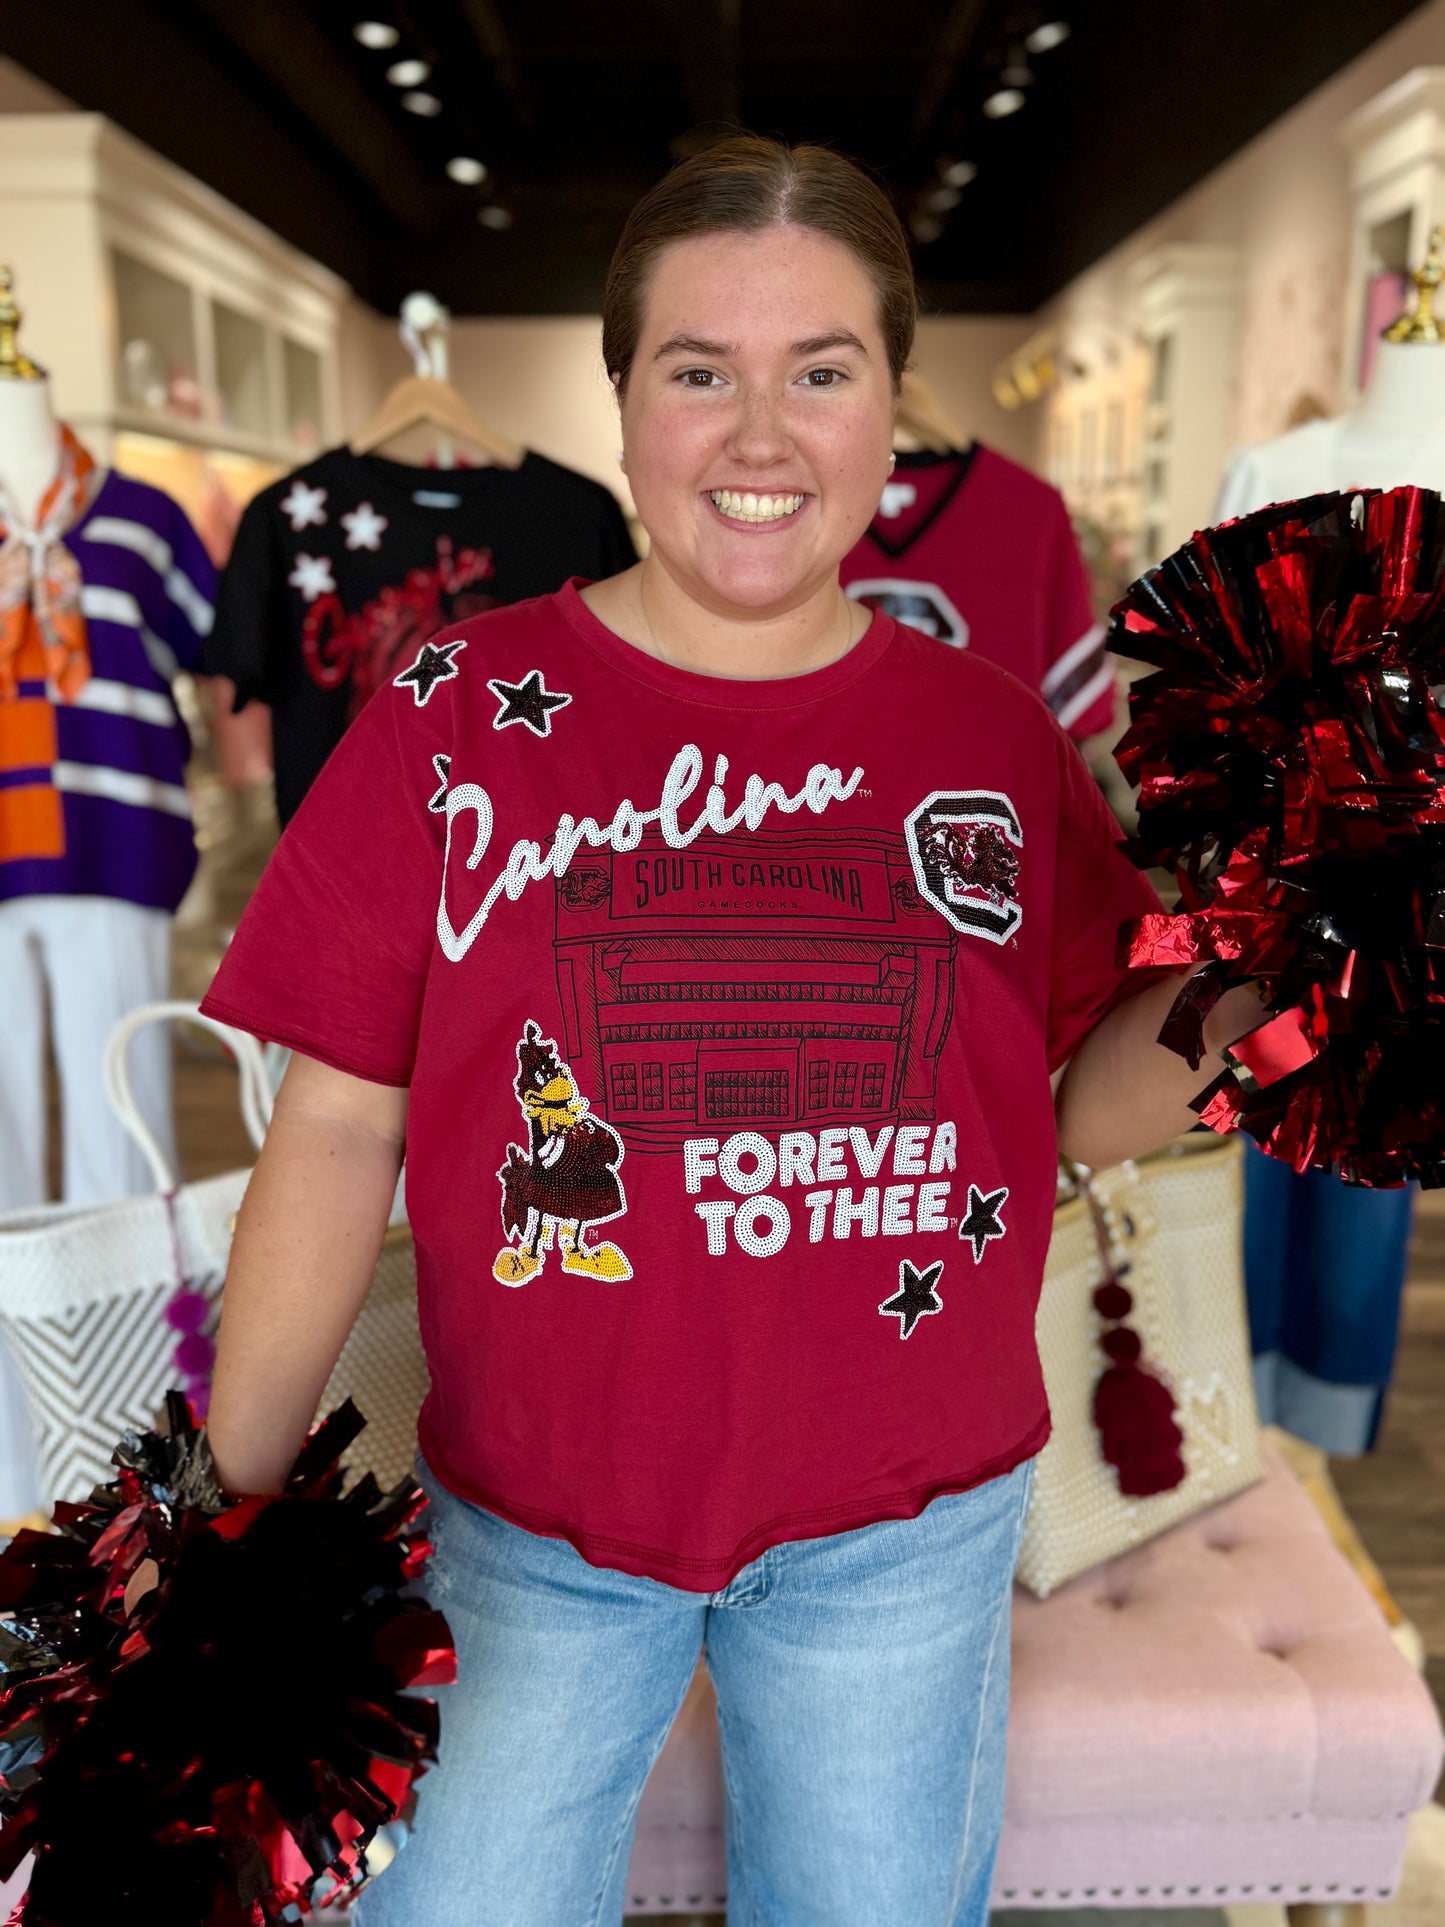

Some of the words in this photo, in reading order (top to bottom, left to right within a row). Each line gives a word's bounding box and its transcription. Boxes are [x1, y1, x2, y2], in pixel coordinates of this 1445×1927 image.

[436, 743, 864, 963] Carolina
[634, 856, 722, 910] SOUTH
[731, 862, 865, 914] CAROLINA
[697, 900, 799, 910] GAMECOCKS
[683, 1121, 957, 1195] FOREVER
[694, 1195, 792, 1259] TO
[804, 1181, 949, 1244] THEE
